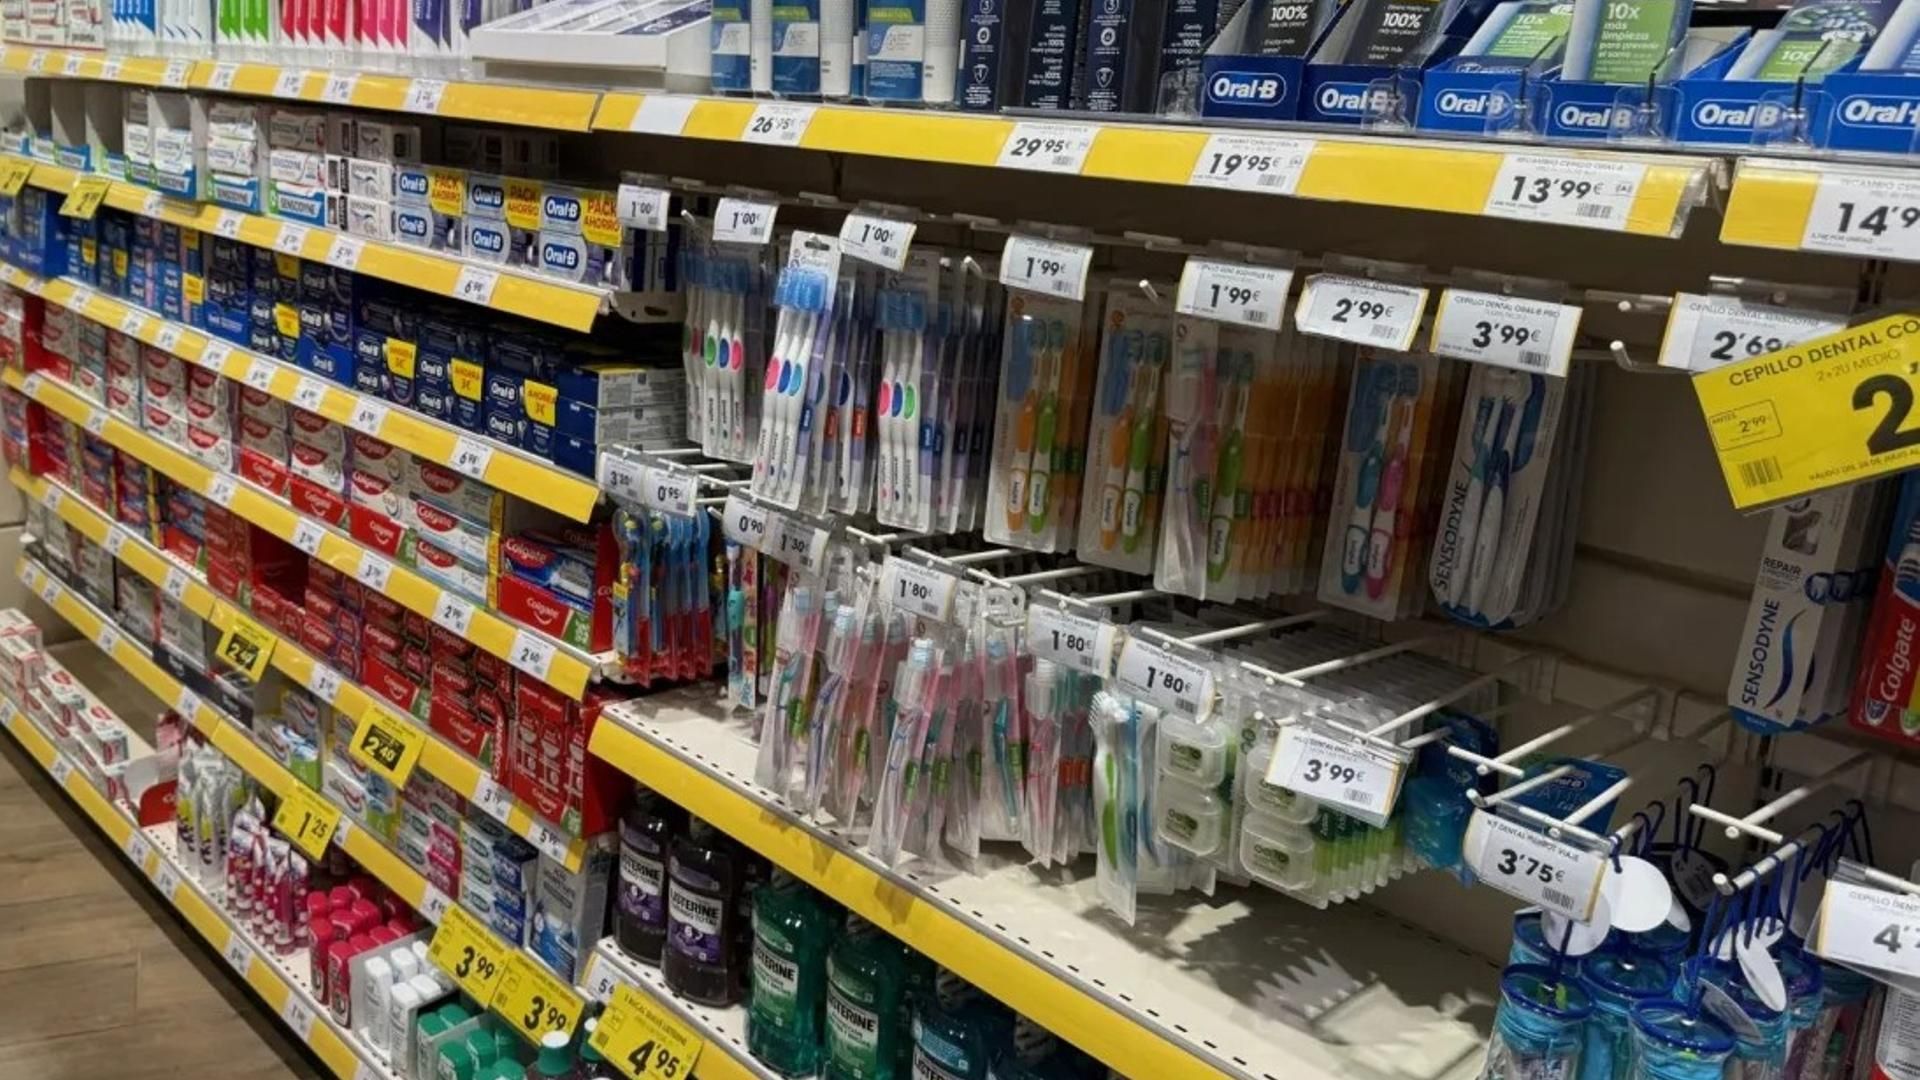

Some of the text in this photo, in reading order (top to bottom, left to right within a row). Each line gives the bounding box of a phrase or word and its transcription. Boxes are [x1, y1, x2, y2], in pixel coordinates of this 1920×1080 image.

[1270, 6, 1307, 21] 100%
[1382, 13, 1421, 28] 100%
[1606, 2, 1639, 19] 10x
[1213, 77, 1278, 100] Oral-B
[1440, 93, 1504, 114] Oral-B
[401, 174, 427, 194] Oral-B
[546, 198, 578, 218] Oral-B
[545, 245, 576, 267] Oral-B
[1209, 283, 1262, 308] 1'99€
[1331, 298, 1394, 323] 2'99€
[1472, 320, 1542, 349] 3'99€
[1729, 354, 1804, 387] CEPILLO
[1807, 331, 1883, 363] DENTAL
[490, 382, 516, 401] Oral-B
[488, 416, 515, 435] Oral-B
[418, 504, 454, 529] Colgate
[1434, 480, 1470, 590] SENSODYNE
[505, 538, 548, 565] Colgate
[1762, 556, 1802, 576] REPAIR
[527, 597, 560, 622] Colgate
[1741, 598, 1781, 706] SENSODYNE
[1880, 618, 1916, 702] Colgate
[1147, 665, 1192, 693] 1'80€
[1303, 759, 1366, 784] 3'99€
[1497, 848, 1566, 884] 3'75€
